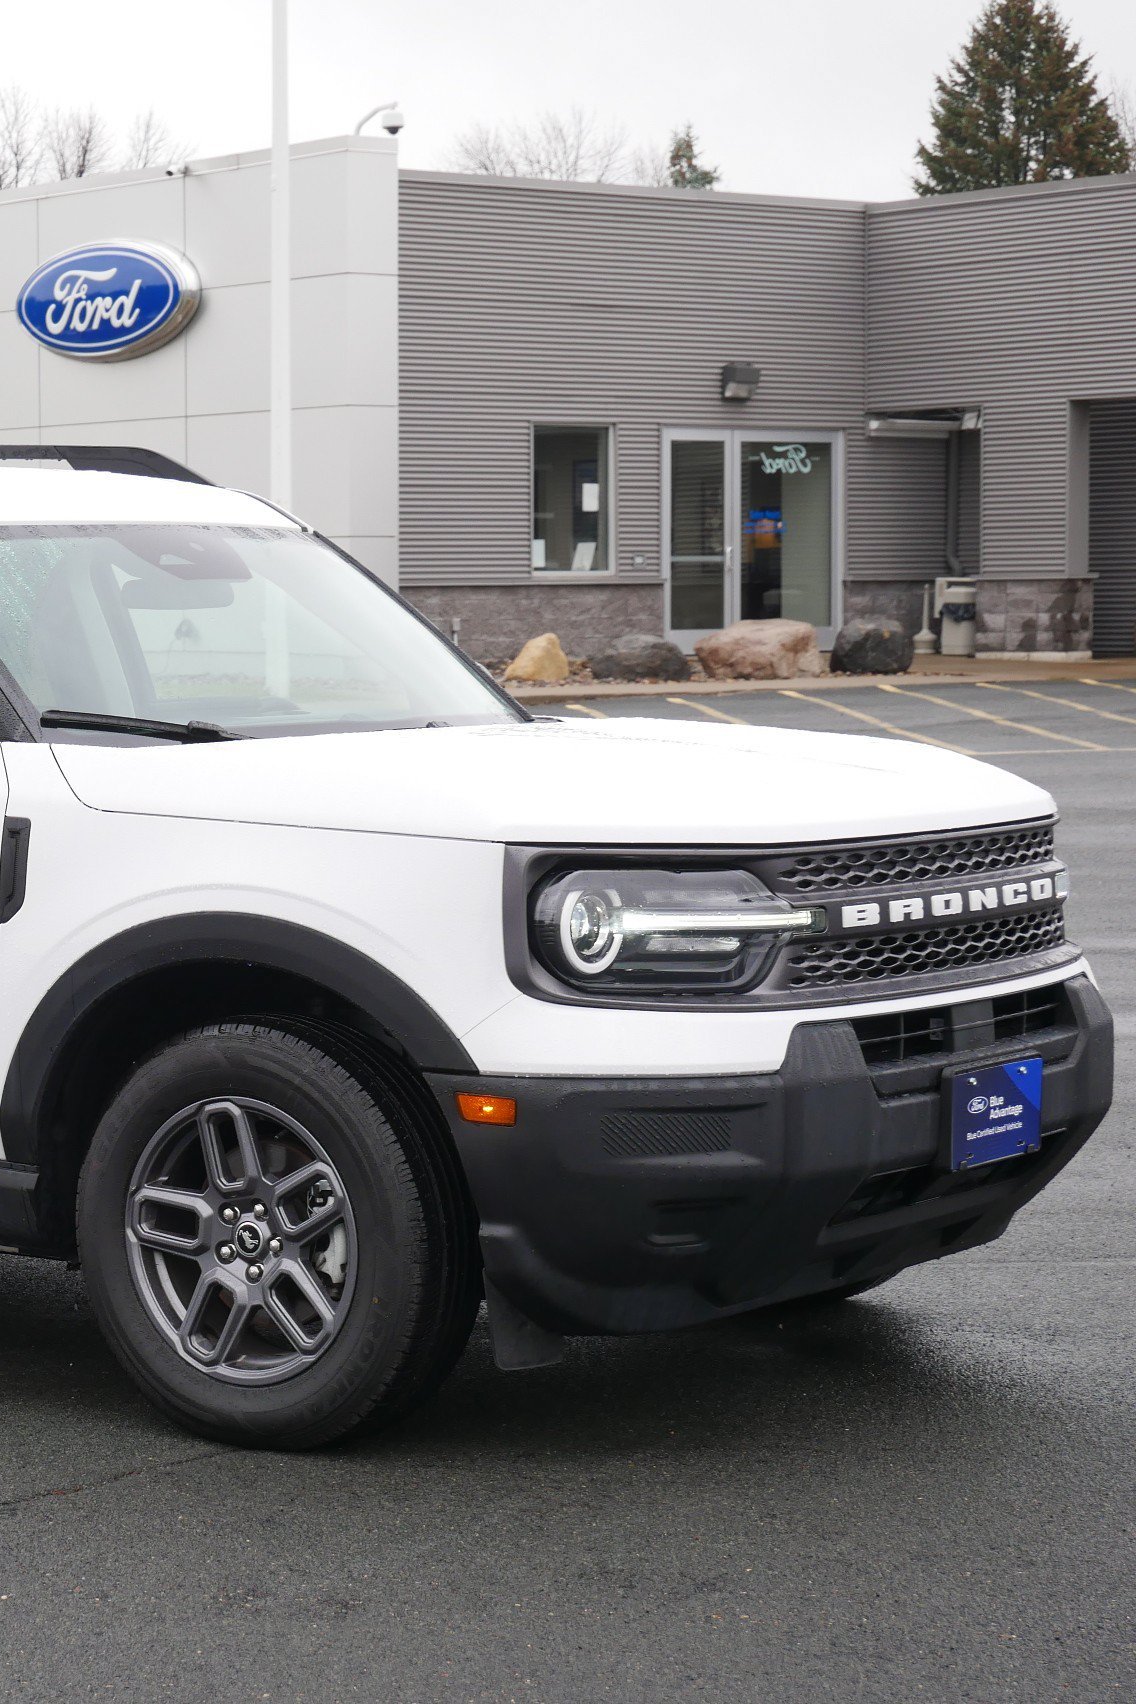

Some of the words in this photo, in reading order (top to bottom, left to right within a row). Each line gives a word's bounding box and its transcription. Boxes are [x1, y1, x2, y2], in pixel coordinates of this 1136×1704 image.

[45, 268, 142, 335] Ford
[841, 878, 1053, 928] BRONCO
[971, 1099, 985, 1111] Ford
[990, 1096, 1004, 1107] Blue
[989, 1104, 1023, 1119] Advantage
[967, 1132, 977, 1140] Blue
